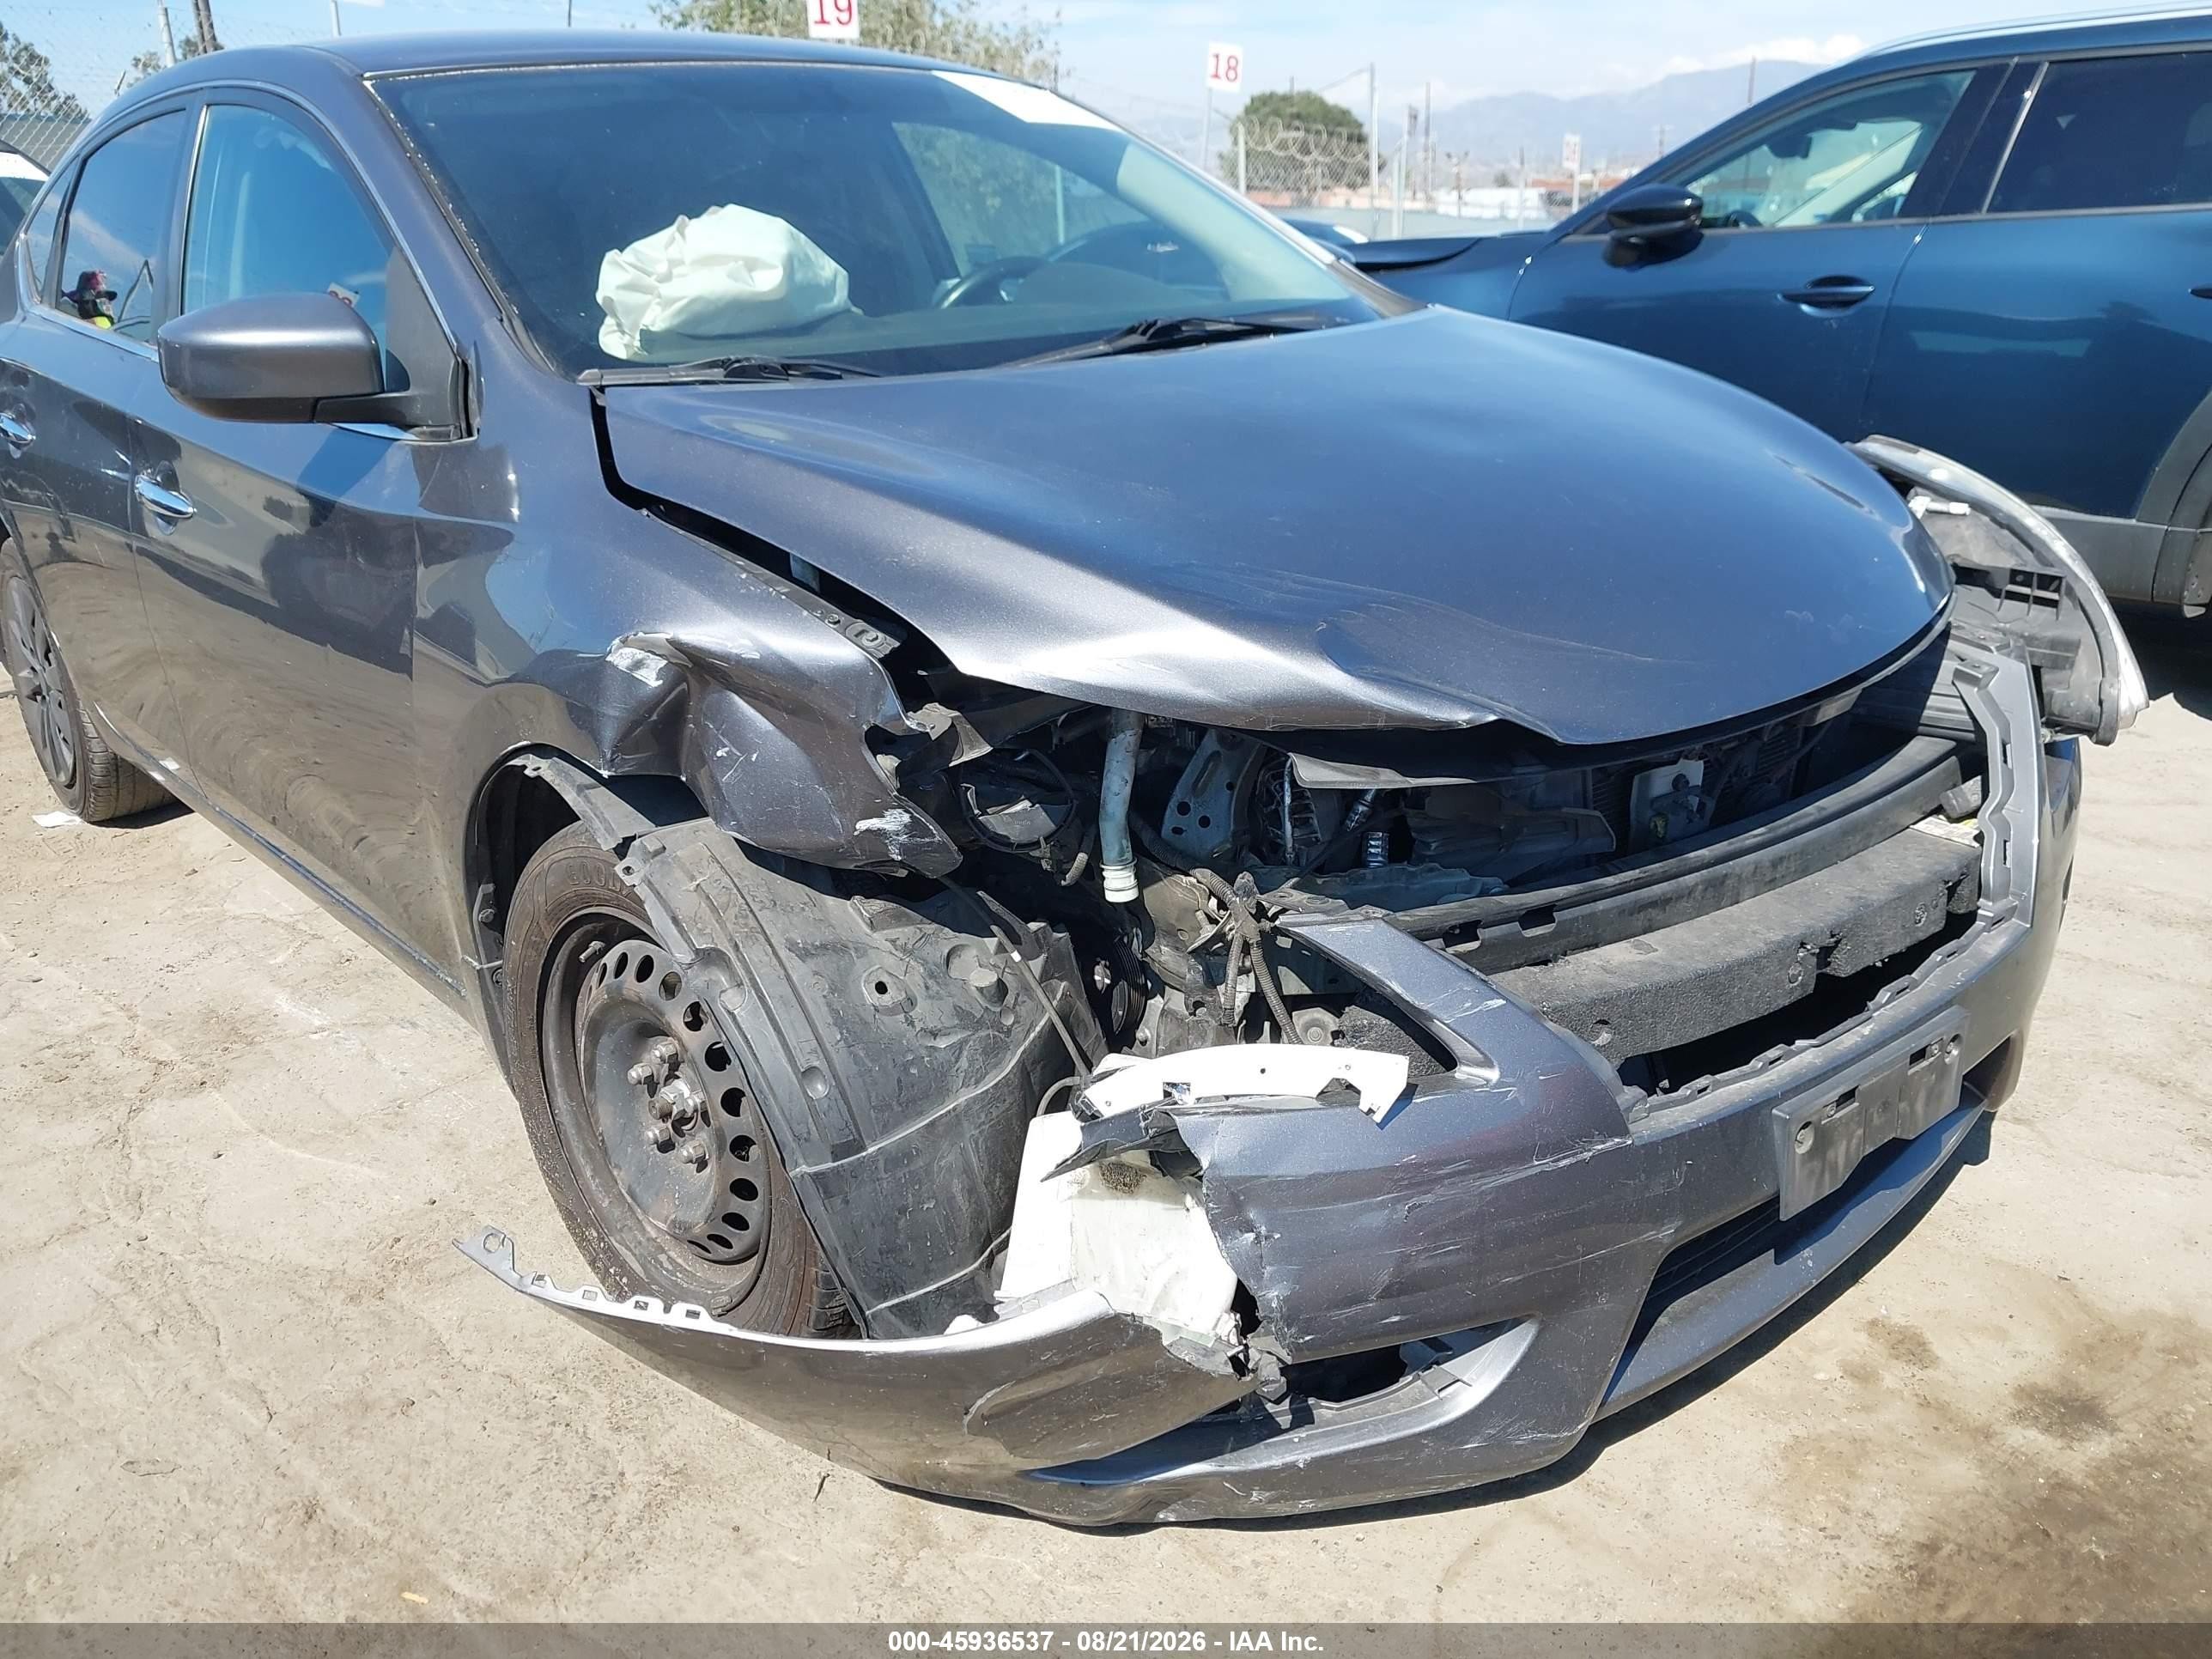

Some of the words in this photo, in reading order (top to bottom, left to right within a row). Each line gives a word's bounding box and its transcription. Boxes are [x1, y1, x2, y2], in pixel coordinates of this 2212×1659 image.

[814, 0, 852, 25] 19
[1210, 53, 1238, 82] 18
[568, 860, 631, 897] GOOD
